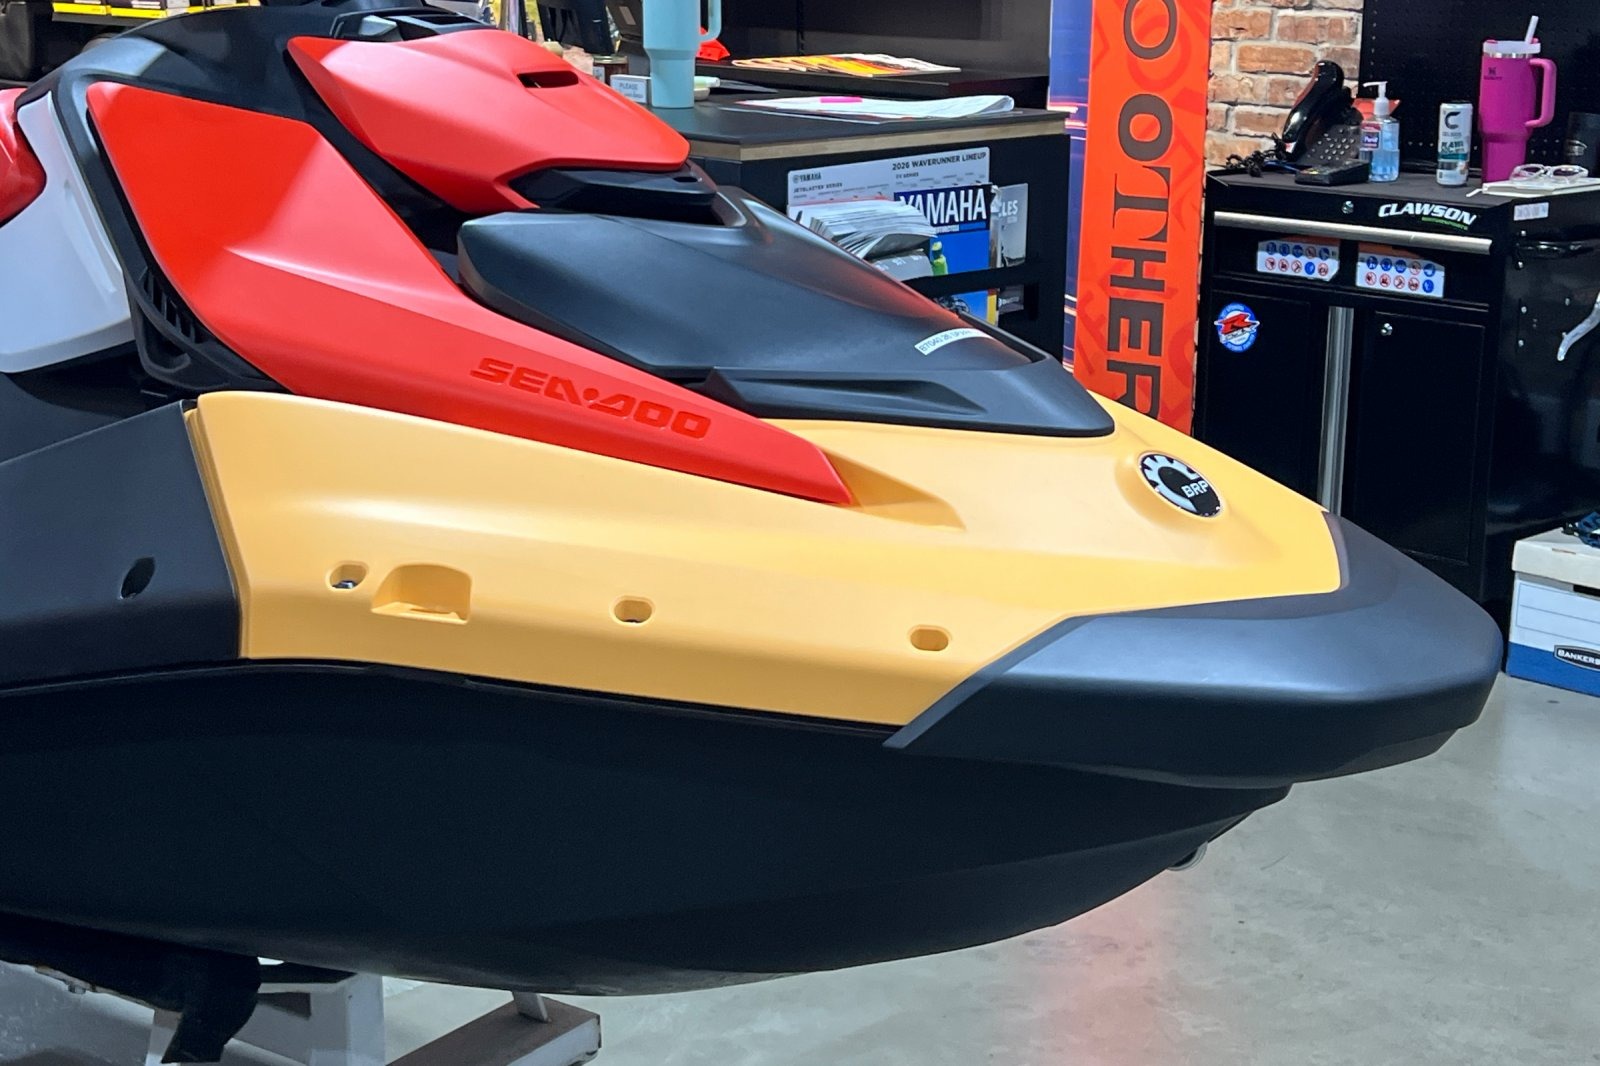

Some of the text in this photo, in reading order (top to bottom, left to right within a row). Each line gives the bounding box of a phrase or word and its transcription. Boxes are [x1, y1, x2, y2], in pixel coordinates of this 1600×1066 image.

[892, 151, 987, 171] 2026 WAVERUNNER LINEUP
[1377, 202, 1477, 226] CLAWSON
[1181, 480, 1209, 498] BRP
